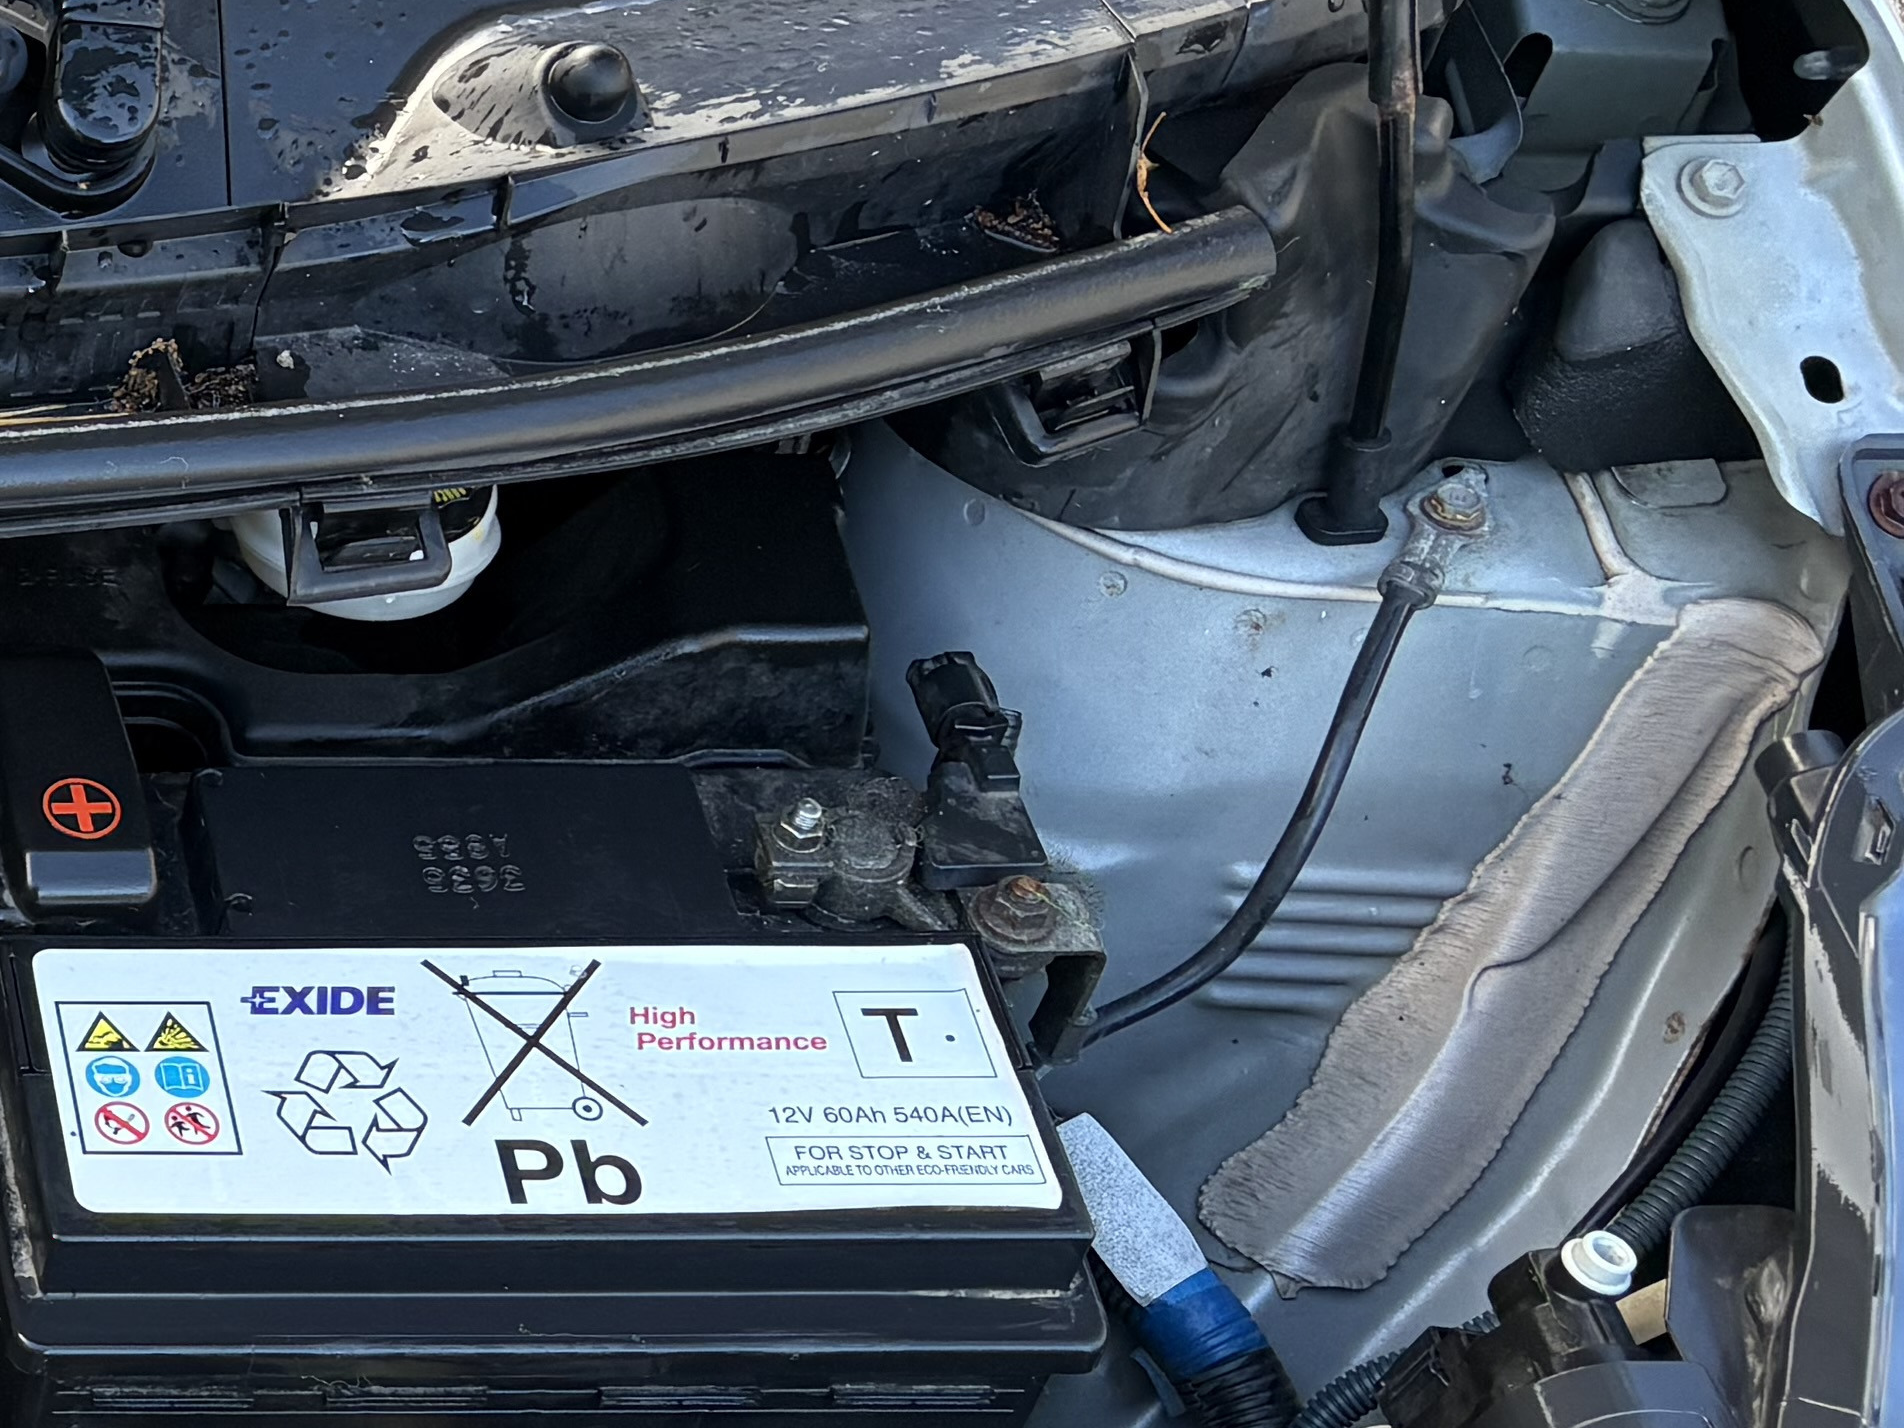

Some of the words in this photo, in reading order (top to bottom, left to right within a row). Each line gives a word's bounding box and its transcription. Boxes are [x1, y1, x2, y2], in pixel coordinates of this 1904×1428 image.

[240, 986, 395, 1015] EXIDE
[629, 1006, 695, 1026] High
[636, 1032, 828, 1051] Performance
[768, 1106, 813, 1123] 12V
[823, 1106, 886, 1123] 60Ah
[894, 1105, 1012, 1127] 540A(EN)
[794, 1145, 842, 1160] FOR
[849, 1145, 908, 1160] STOP
[917, 1145, 932, 1160] &
[939, 1145, 1007, 1160] START
[494, 1139, 643, 1205] Pb
[786, 1164, 854, 1176] APPLICABLE
[856, 1164, 872, 1176] TO
[875, 1164, 914, 1176] OTHER
[917, 1164, 999, 1176] ECO-FRIENDLY
[1002, 1164, 1035, 1176] CARS
